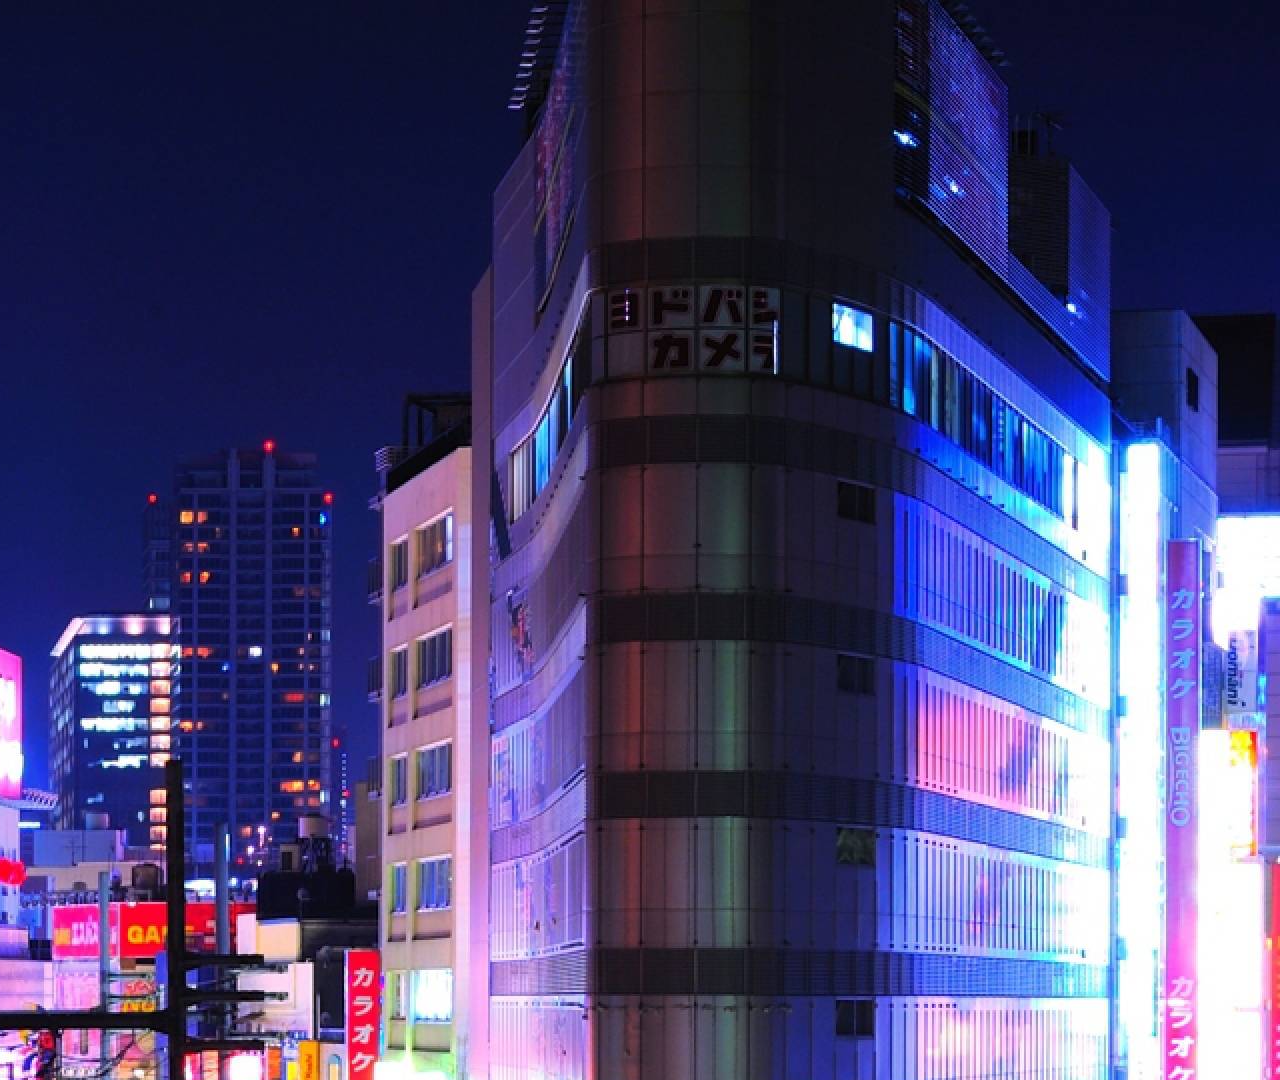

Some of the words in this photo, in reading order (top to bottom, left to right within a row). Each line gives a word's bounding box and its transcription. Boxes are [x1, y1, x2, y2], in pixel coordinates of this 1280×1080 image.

[1170, 587, 1197, 700] カラオケ
[351, 967, 375, 1072] カラオケ
